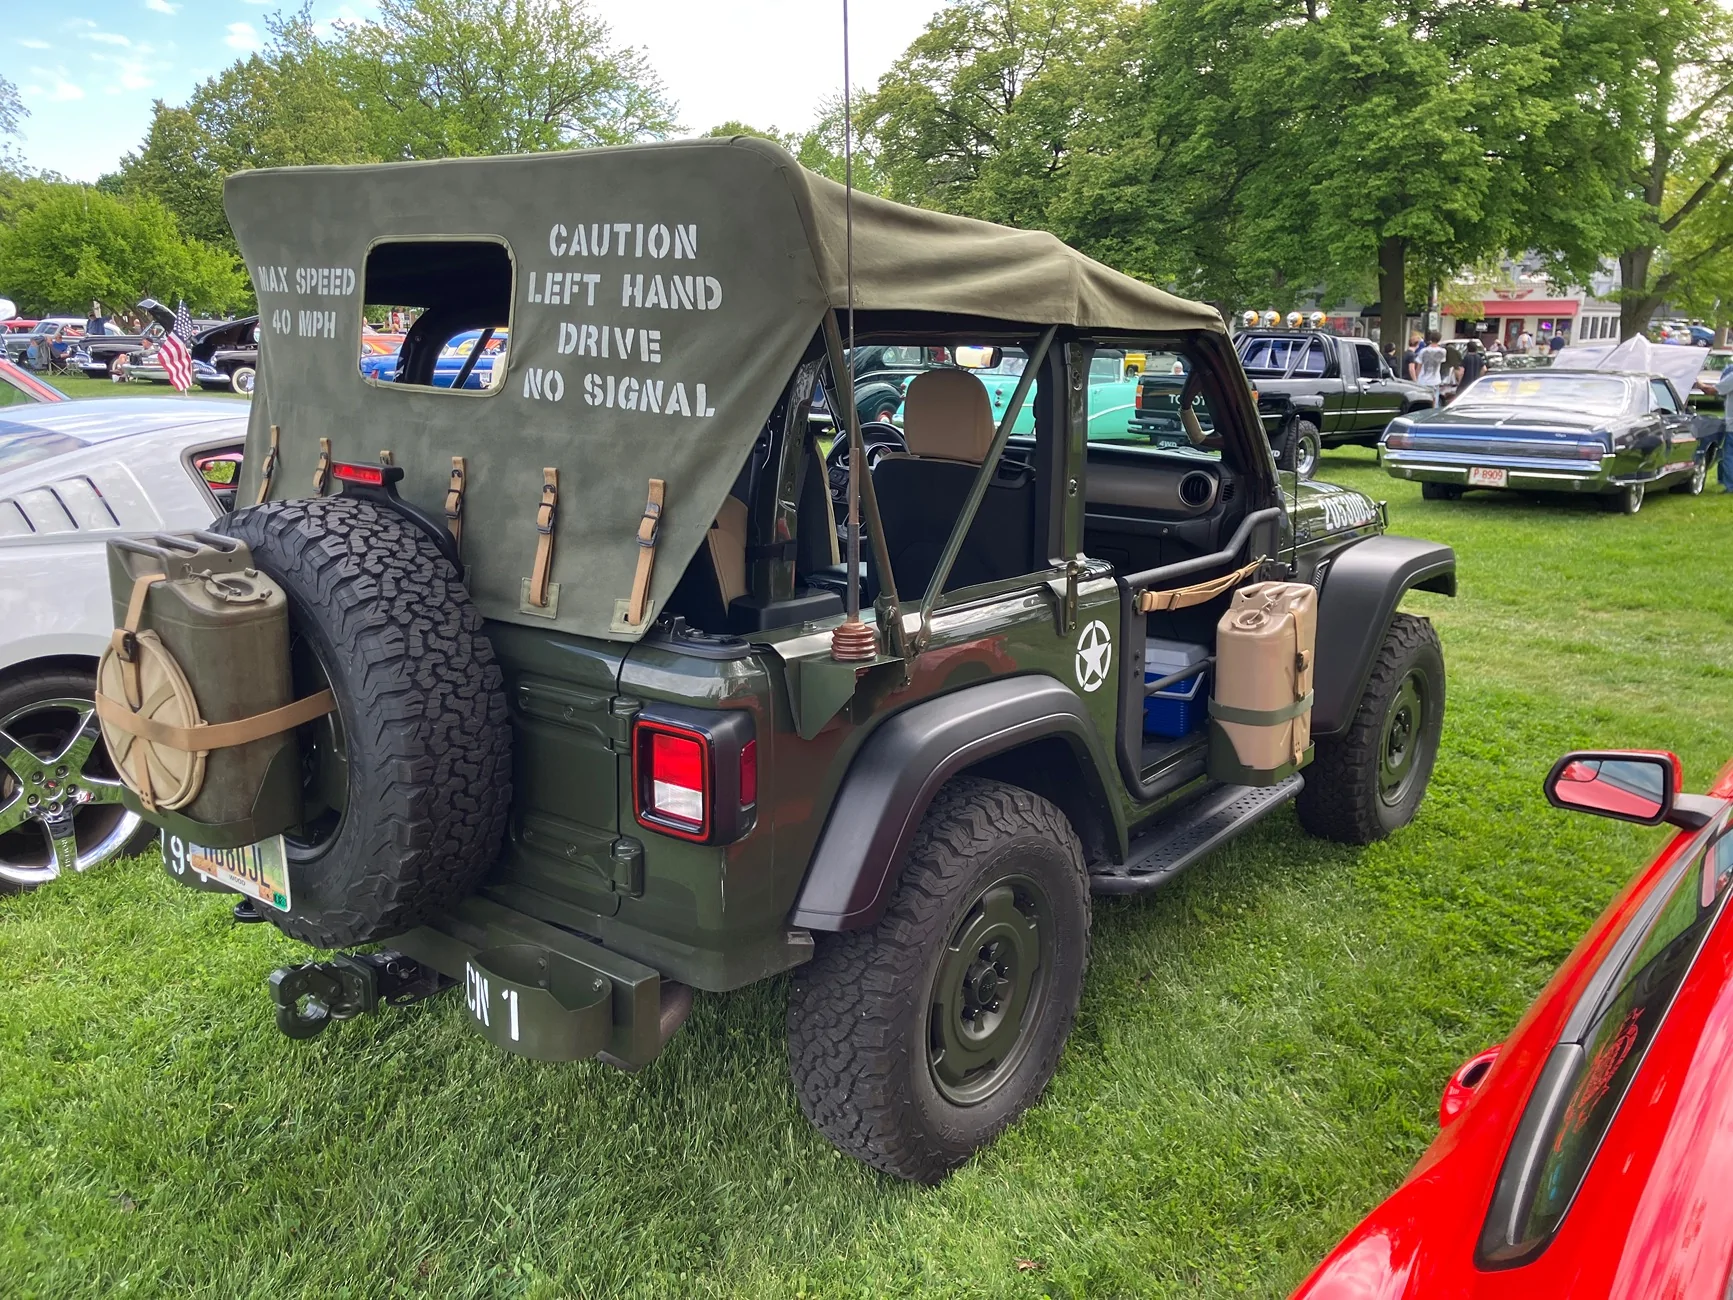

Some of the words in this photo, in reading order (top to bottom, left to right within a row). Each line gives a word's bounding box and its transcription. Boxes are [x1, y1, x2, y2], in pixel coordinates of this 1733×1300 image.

[549, 223, 697, 258] CAUTION
[258, 266, 288, 293] MAX
[296, 267, 355, 296] SPEED
[528, 271, 601, 306] LEFT
[621, 274, 723, 310] HAND
[272, 309, 292, 335] 40
[298, 310, 337, 338] MPH
[558, 322, 663, 363] DRIVE
[522, 368, 565, 402] NO
[583, 373, 717, 418] SIGNAL
[1168, 393, 1206, 406] TOOT
[1482, 470, 1503, 481] 8909
[228, 873, 247, 888] WOOD
[466, 961, 490, 1027] CN
[501, 989, 520, 1042] 1
